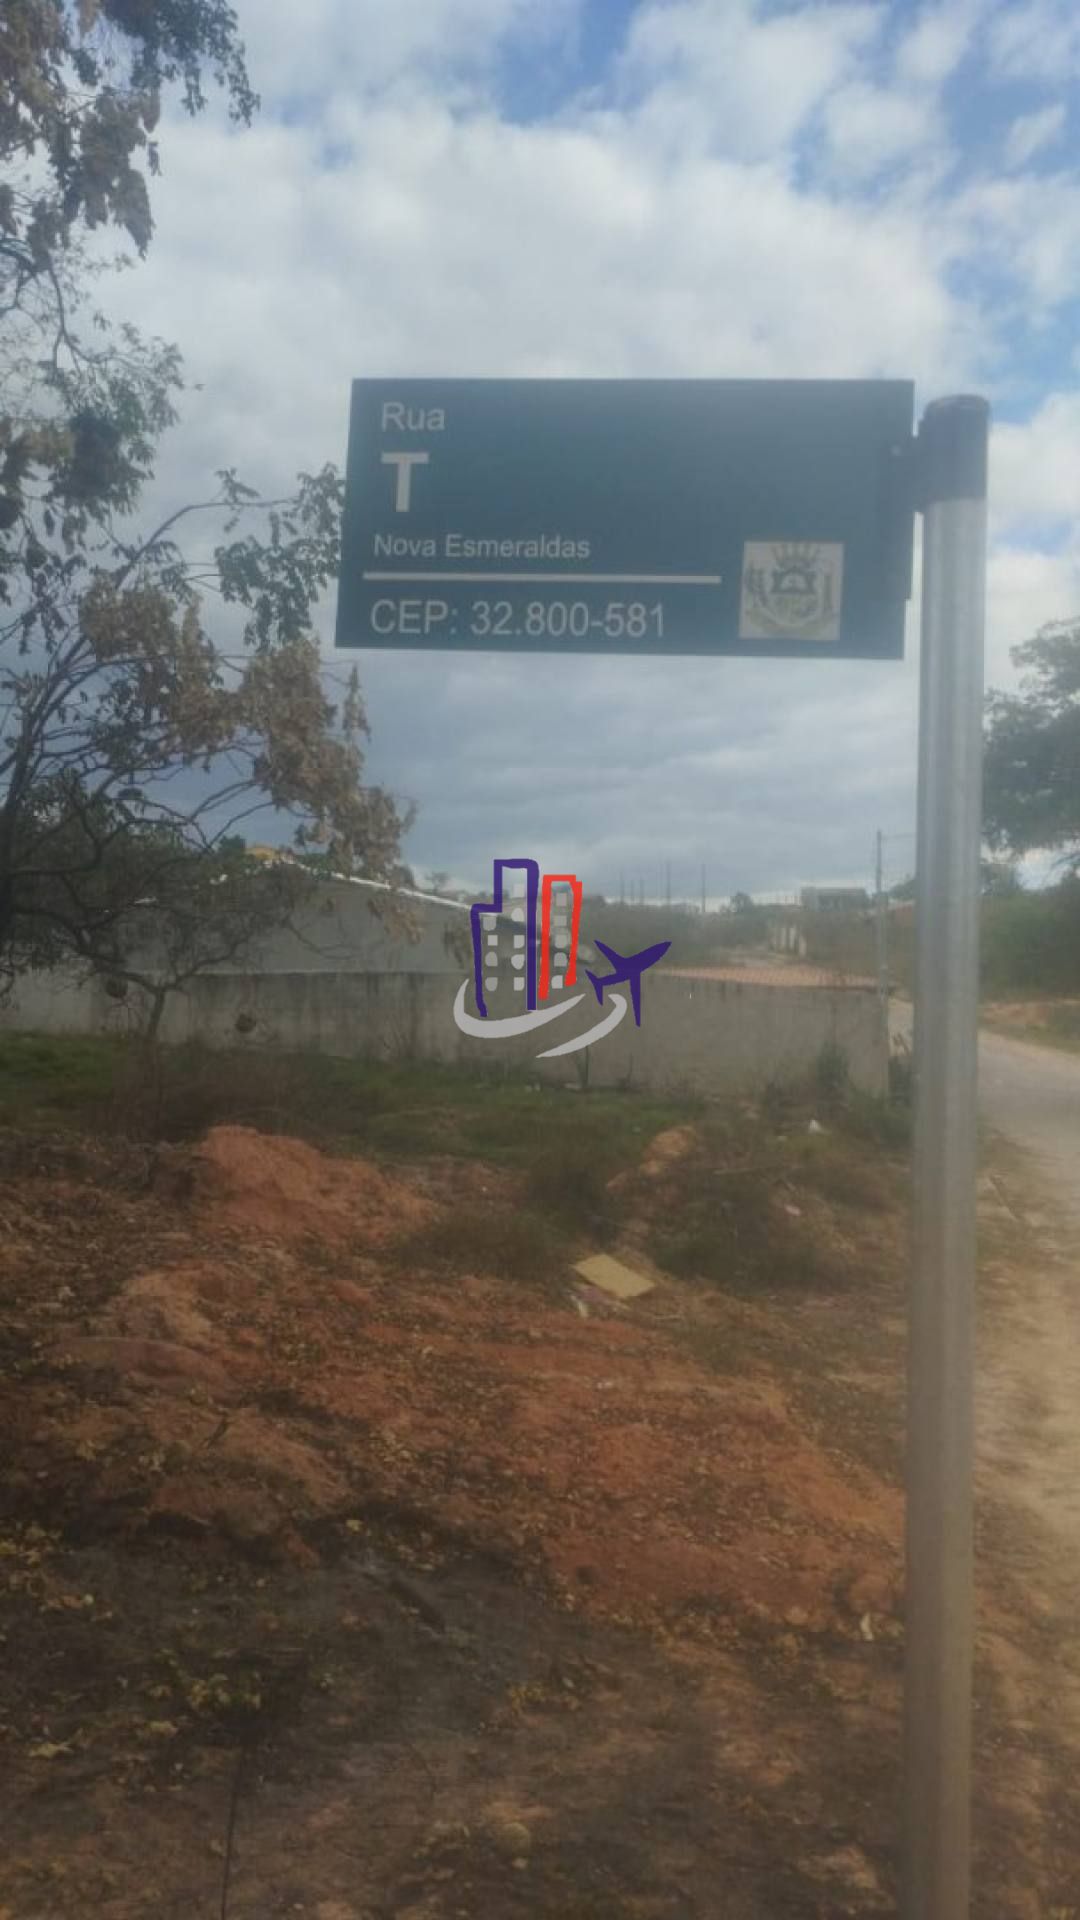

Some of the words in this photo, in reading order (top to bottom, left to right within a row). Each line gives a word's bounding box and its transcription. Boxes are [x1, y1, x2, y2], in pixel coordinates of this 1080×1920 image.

[381, 401, 446, 432] Rua
[380, 451, 430, 512] T
[373, 533, 436, 557] Nova
[445, 534, 591, 559] Esmeraldas
[370, 599, 459, 635] CEP:
[470, 601, 664, 637] 32.800-581
